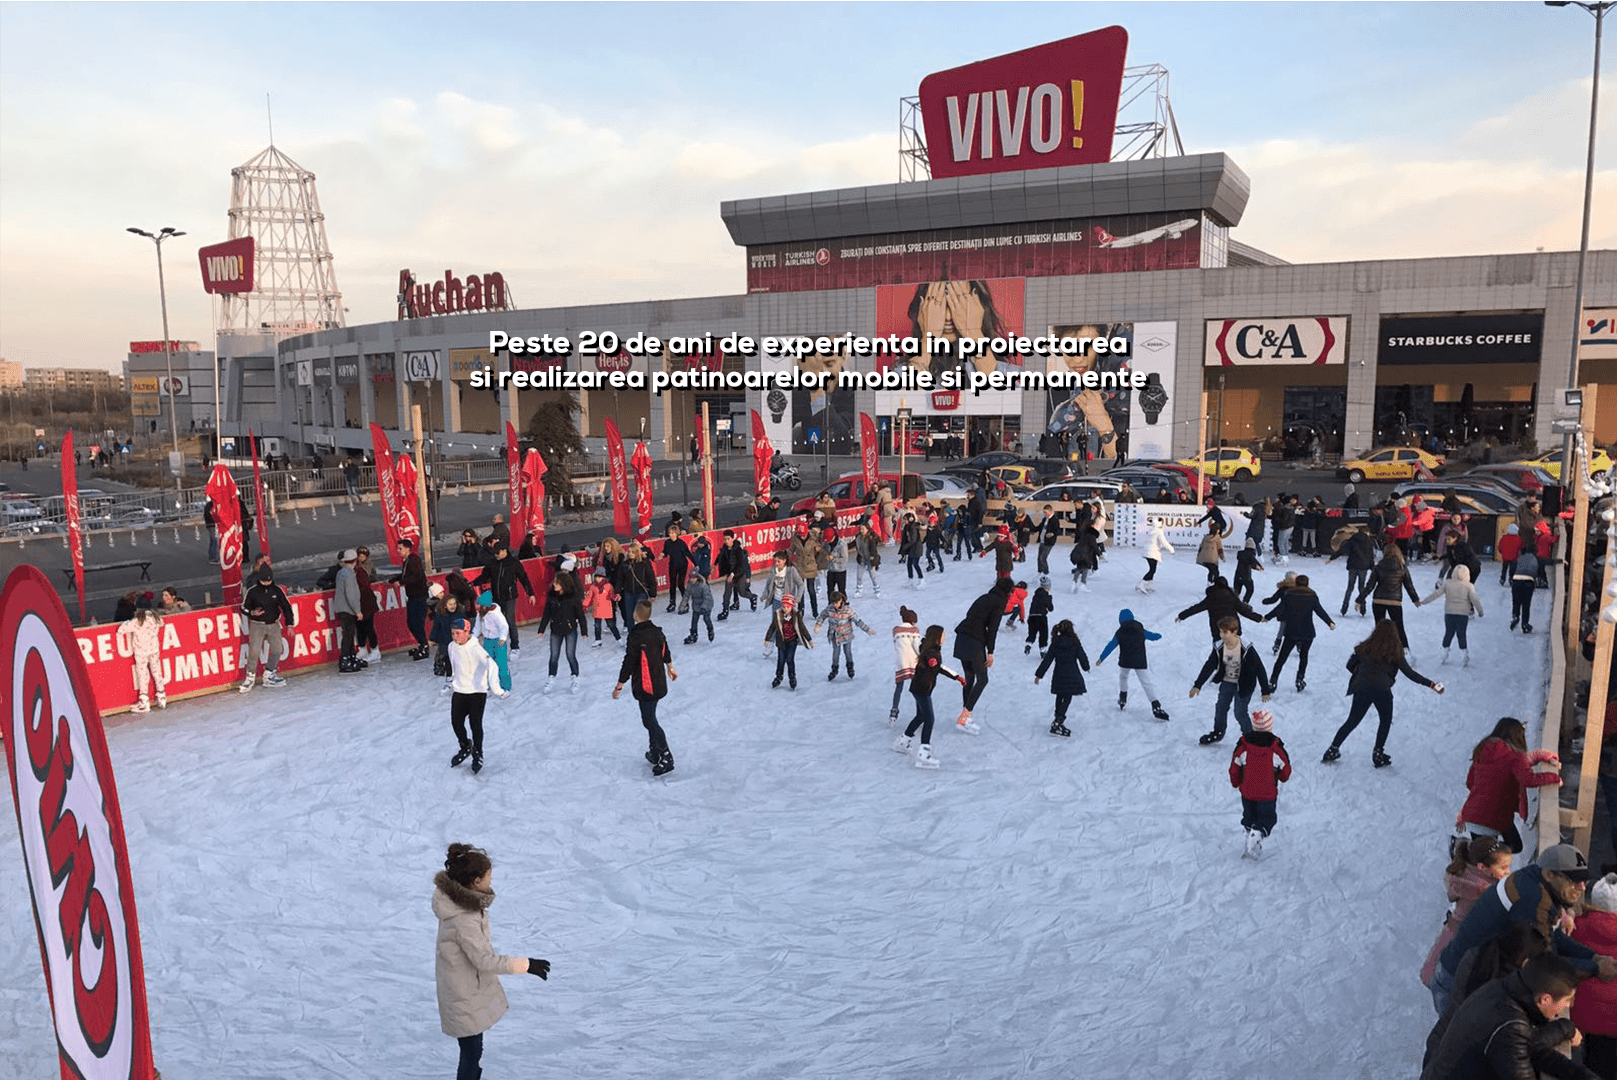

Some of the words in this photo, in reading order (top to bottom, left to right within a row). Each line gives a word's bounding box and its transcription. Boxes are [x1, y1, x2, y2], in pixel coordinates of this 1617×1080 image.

[946, 79, 1085, 162] VIVO!
[785, 250, 815, 260] TURKISH
[864, 246, 874, 256] DIN
[907, 243, 922, 253] SPRE
[923, 241, 949, 252] DIFERITE
[984, 238, 995, 247] DIN
[996, 236, 1013, 246] LUME
[1014, 235, 1023, 245] CU
[1024, 233, 1051, 244] TURKISH
[1052, 231, 1082, 242] AIRLINES
[206, 255, 244, 281] VIVO!
[785, 258, 816, 267] AIRLINES
[398, 268, 505, 321] Auchan
[1236, 323, 1307, 359] C&A
[1388, 335, 1473, 347] STARBUCKS
[1476, 334, 1532, 345] COFFEE
[410, 354, 432, 378] C&A
[599, 352, 630, 370] Hervis
